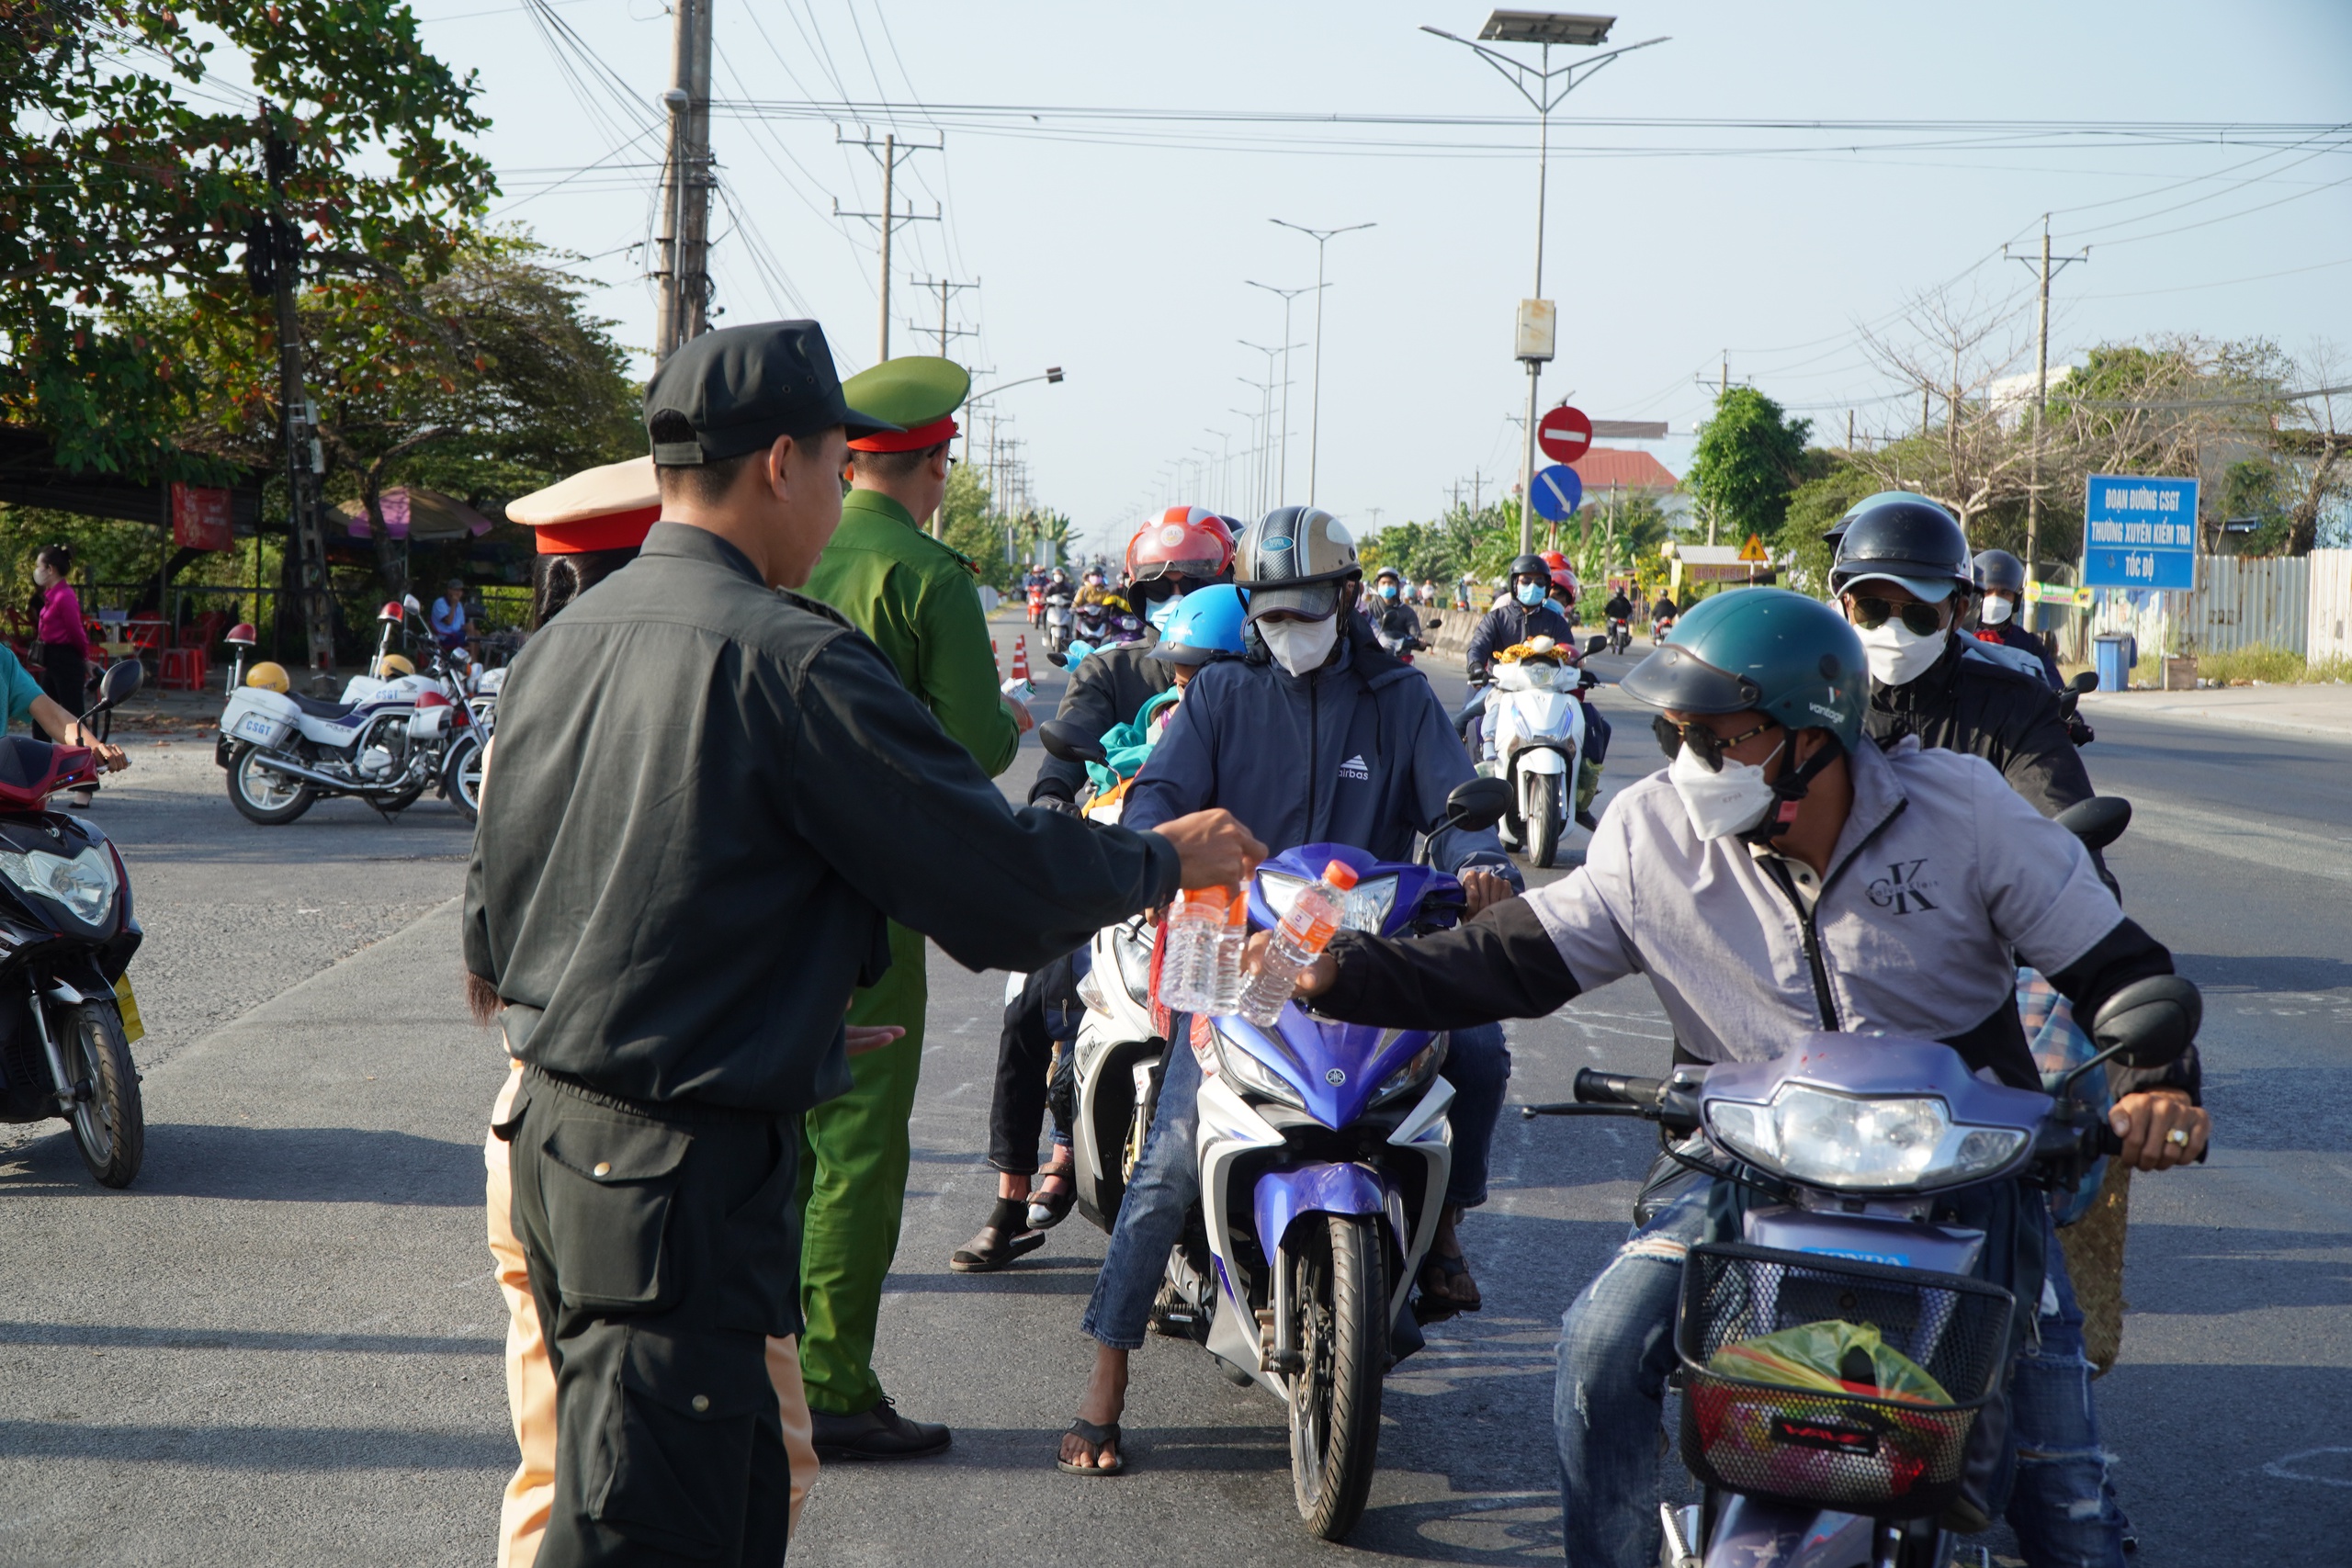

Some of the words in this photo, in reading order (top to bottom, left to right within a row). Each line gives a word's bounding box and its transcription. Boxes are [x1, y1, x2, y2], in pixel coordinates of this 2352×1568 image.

[2105, 489, 2128, 513] ĐOẠN
[2130, 485, 2157, 512] ĐƯỜNG
[2159, 491, 2180, 512] CSGT
[2091, 517, 2123, 543] THƯỜNG
[2124, 519, 2152, 544] XUYÊN
[2154, 516, 2174, 545] KIỂM
[2176, 525, 2191, 546] TRA
[2125, 549, 2141, 577] TỐC
[2143, 553, 2154, 581] ĐỘ
[376, 690, 398, 700] CSGT
[1809, 702, 1845, 724] vantage
[245, 720, 272, 735] CSGT
[1812, 1249, 1904, 1267] NDA
